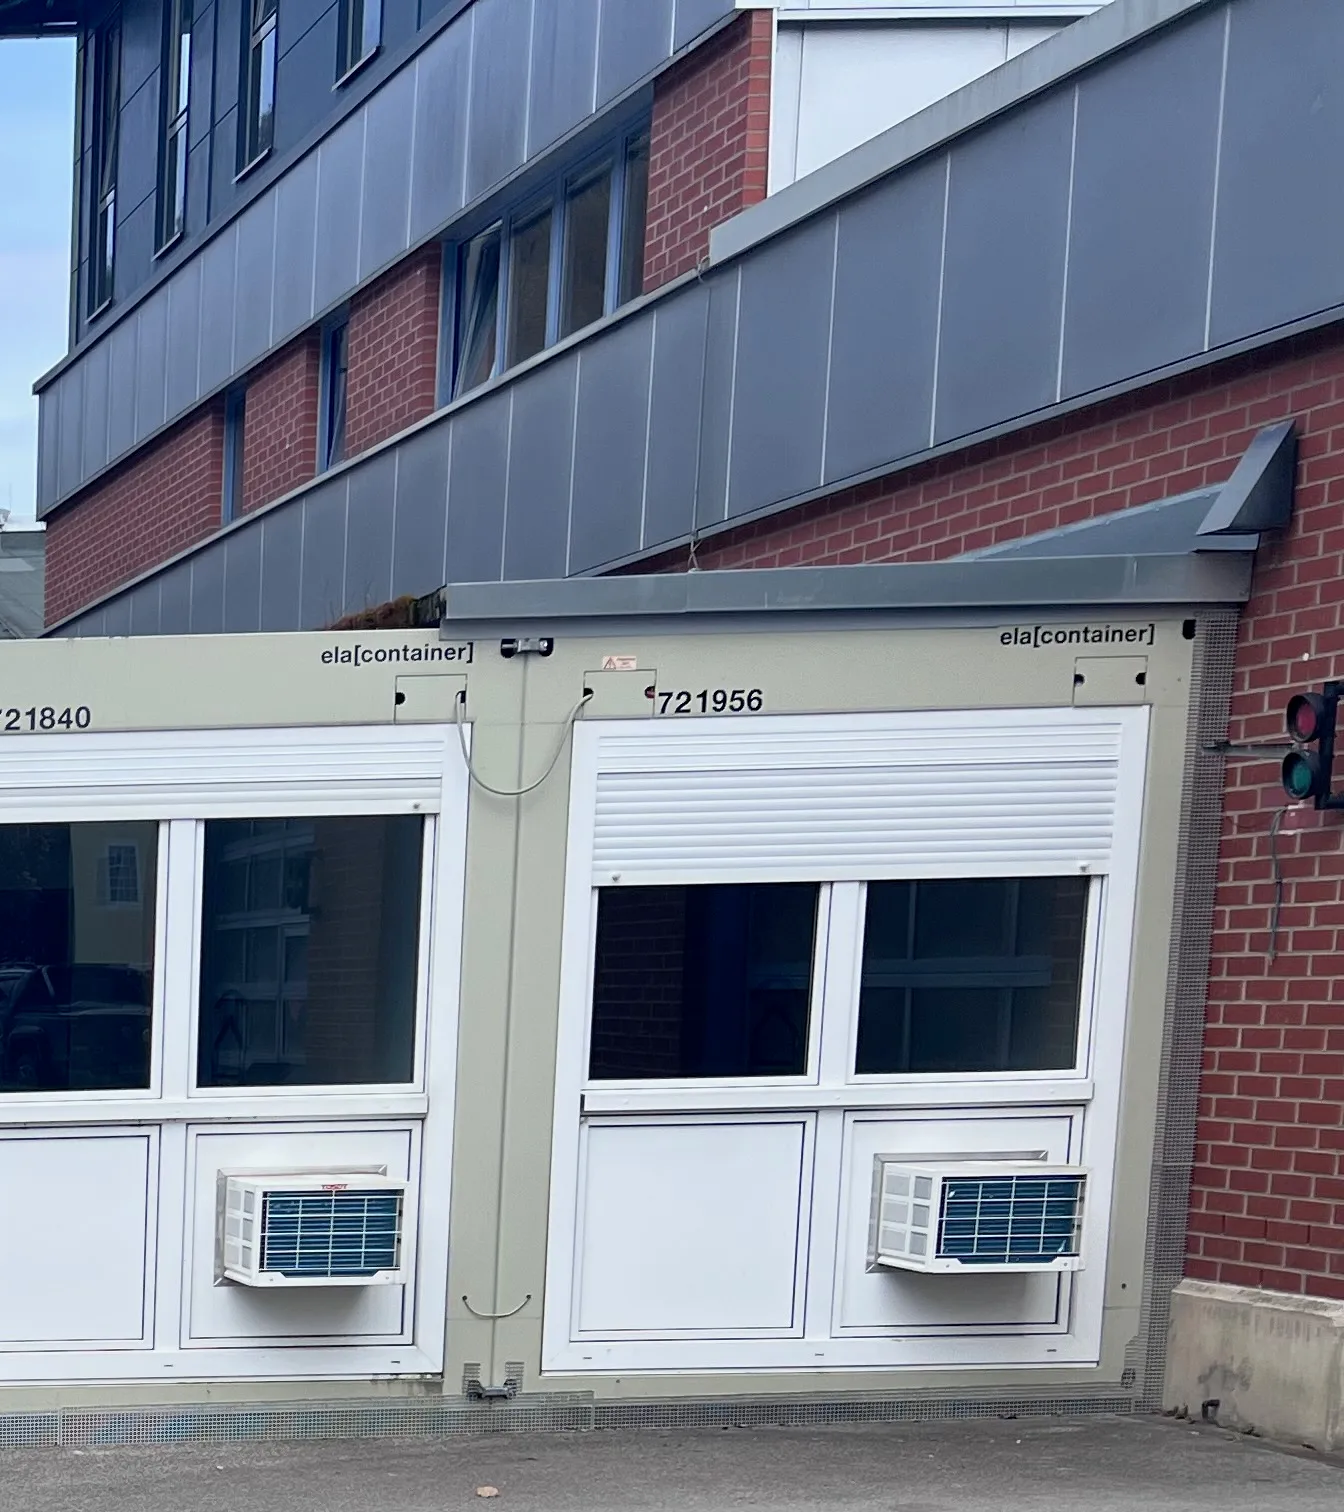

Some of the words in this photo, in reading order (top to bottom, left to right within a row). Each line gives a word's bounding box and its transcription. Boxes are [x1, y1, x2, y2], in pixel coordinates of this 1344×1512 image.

[999, 624, 1156, 649] ela[container]
[320, 641, 474, 668] ela[container]
[657, 689, 764, 714] 721956
